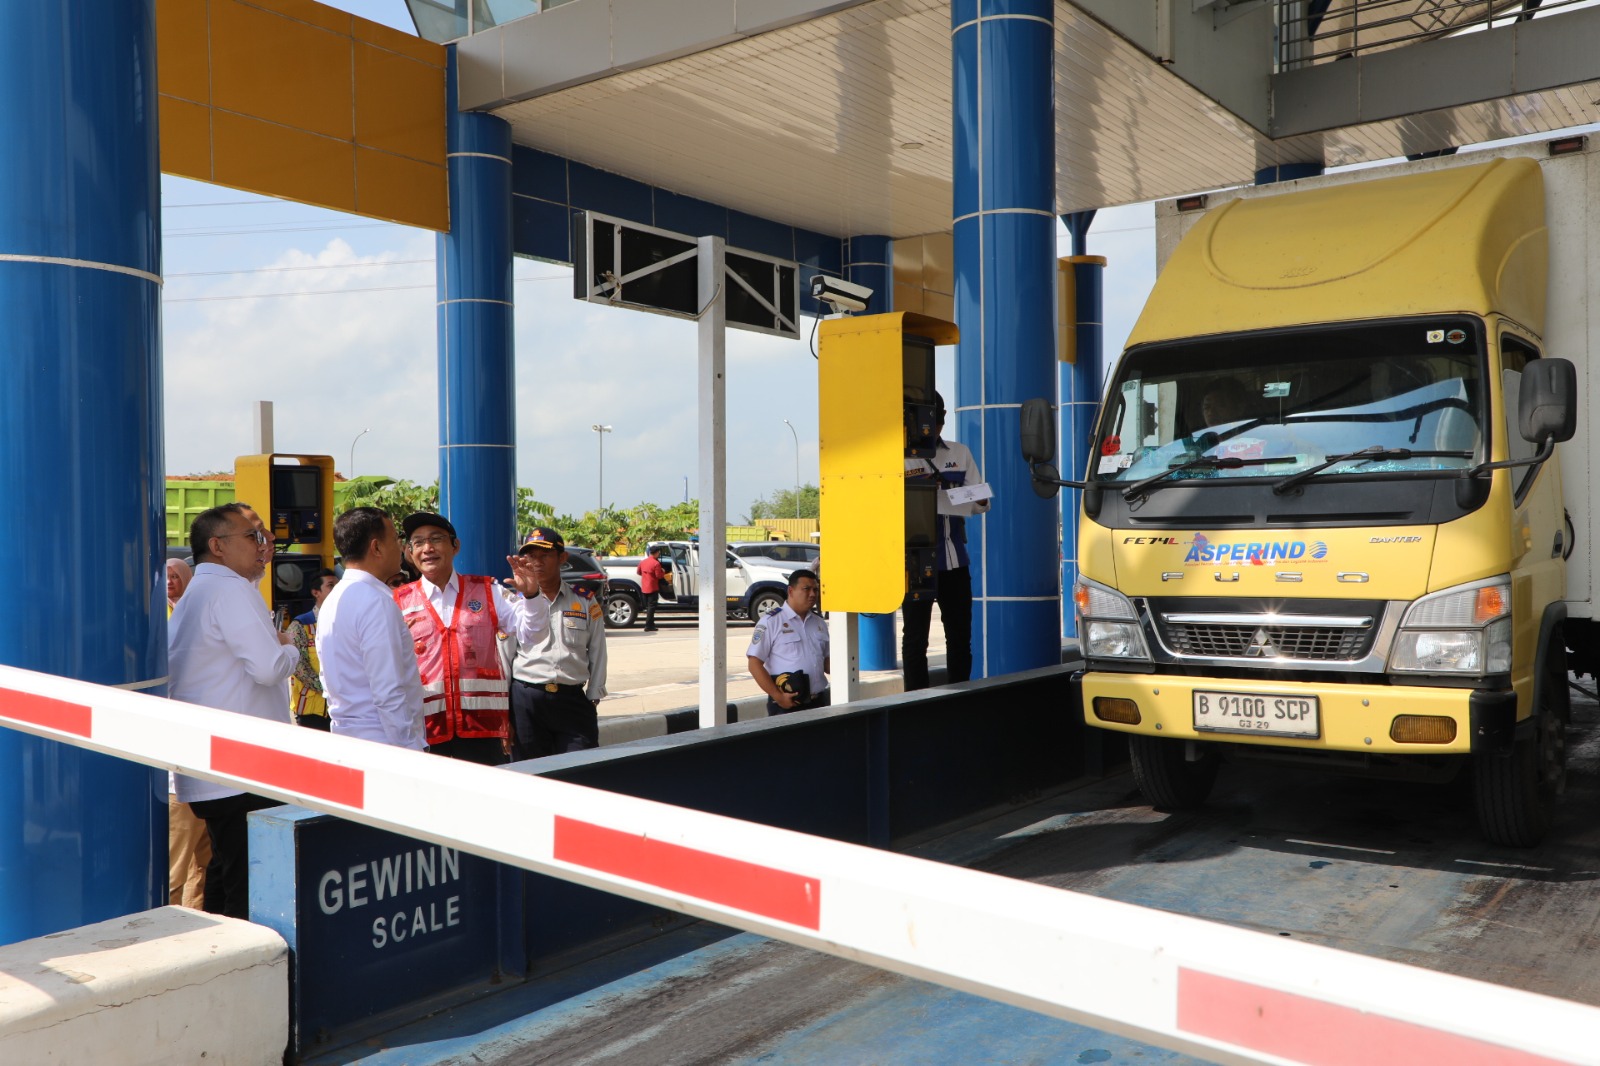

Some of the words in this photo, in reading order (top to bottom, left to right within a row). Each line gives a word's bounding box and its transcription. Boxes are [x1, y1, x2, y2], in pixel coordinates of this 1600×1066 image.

[1122, 537, 1179, 545] FE74L
[1369, 536, 1422, 544] CANTER
[1184, 541, 1306, 563] ASPERIND
[1161, 571, 1370, 583] FUSO
[1199, 695, 1210, 715] B
[1219, 696, 1265, 718] 9100
[1274, 699, 1310, 721] SCP
[318, 846, 460, 915] GEWINN
[372, 895, 460, 949] SCALE
